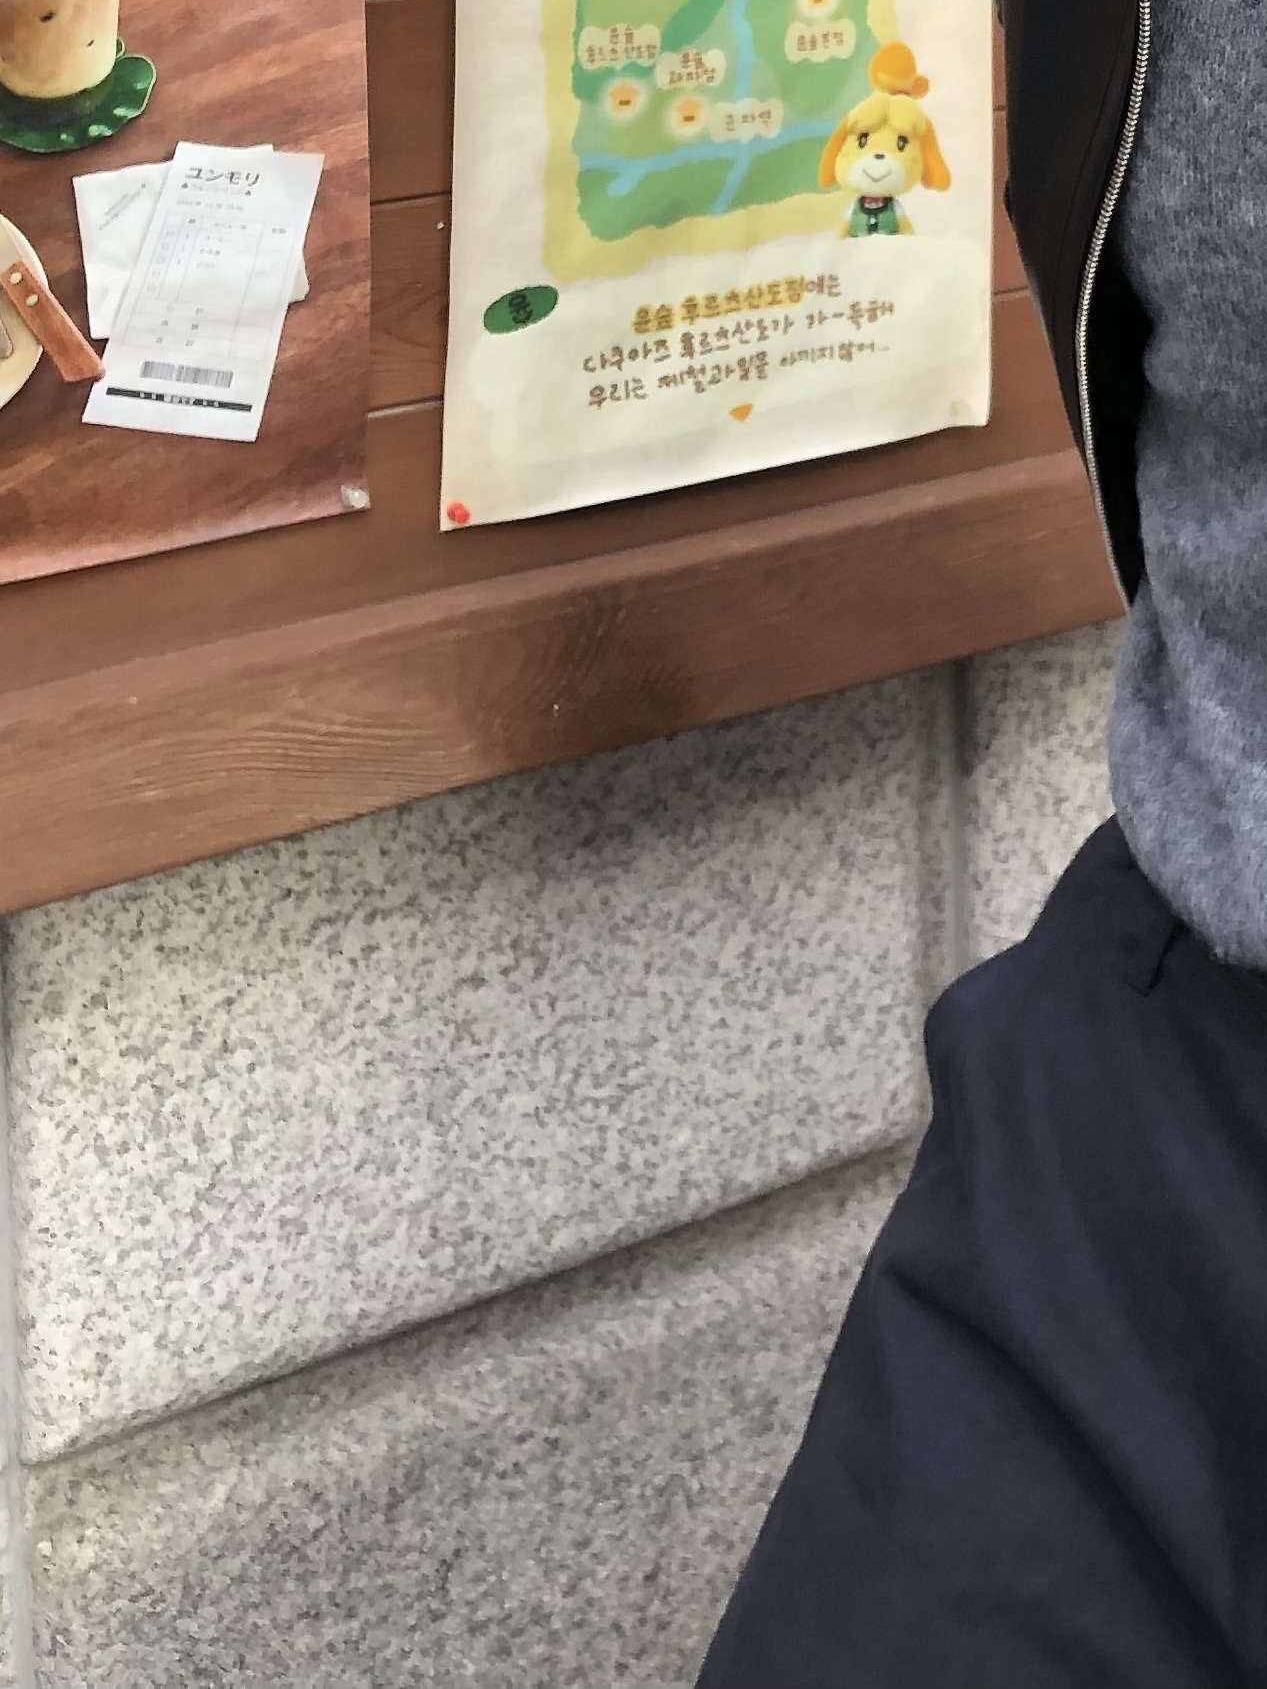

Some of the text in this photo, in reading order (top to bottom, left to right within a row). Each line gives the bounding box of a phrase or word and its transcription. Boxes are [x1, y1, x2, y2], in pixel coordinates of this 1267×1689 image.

[184, 166, 261, 187] ユンモリ
[588, 376, 649, 410] 우리는
